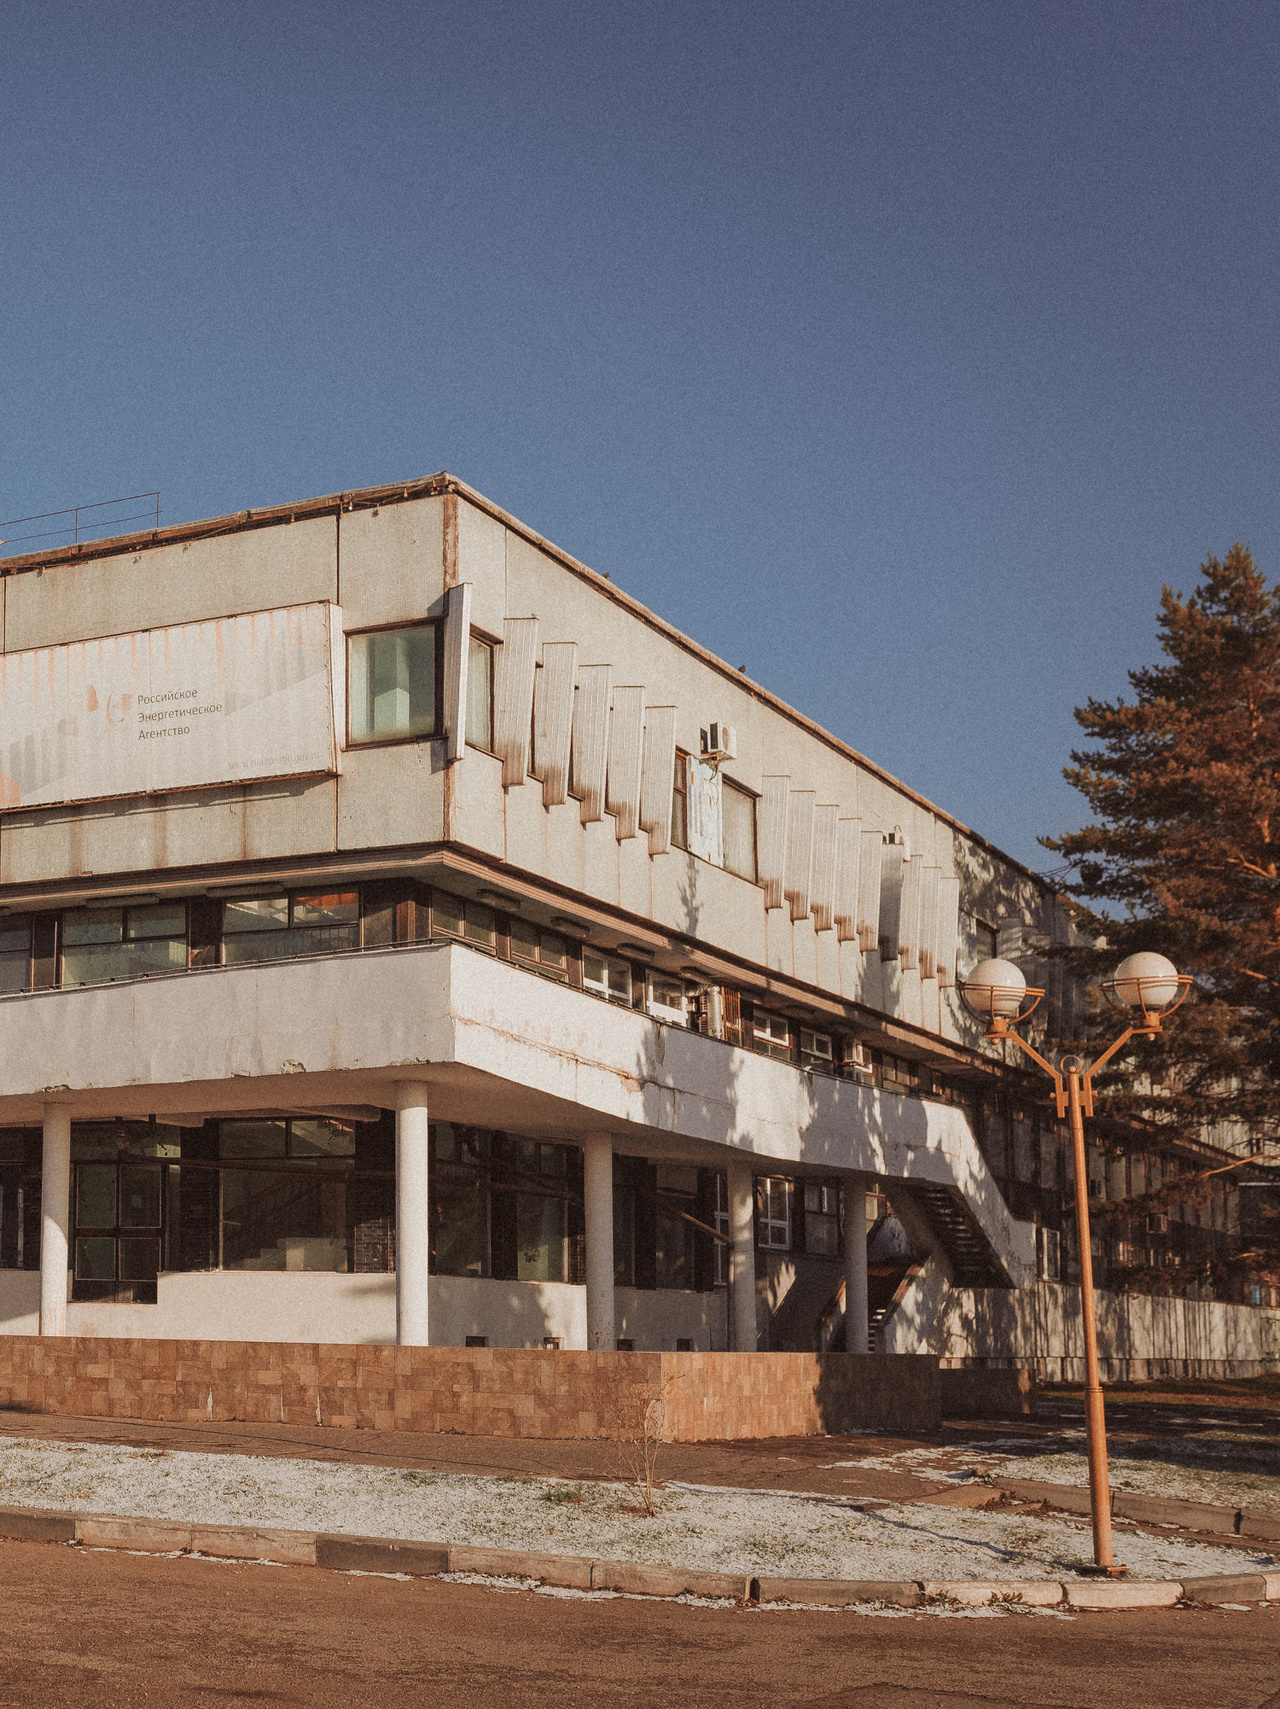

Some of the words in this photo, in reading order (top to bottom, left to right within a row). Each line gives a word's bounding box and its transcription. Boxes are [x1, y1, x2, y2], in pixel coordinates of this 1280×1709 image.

[137, 689, 198, 706] Российское
[137, 702, 223, 723] Энергетическое
[137, 725, 191, 741] Агентство
